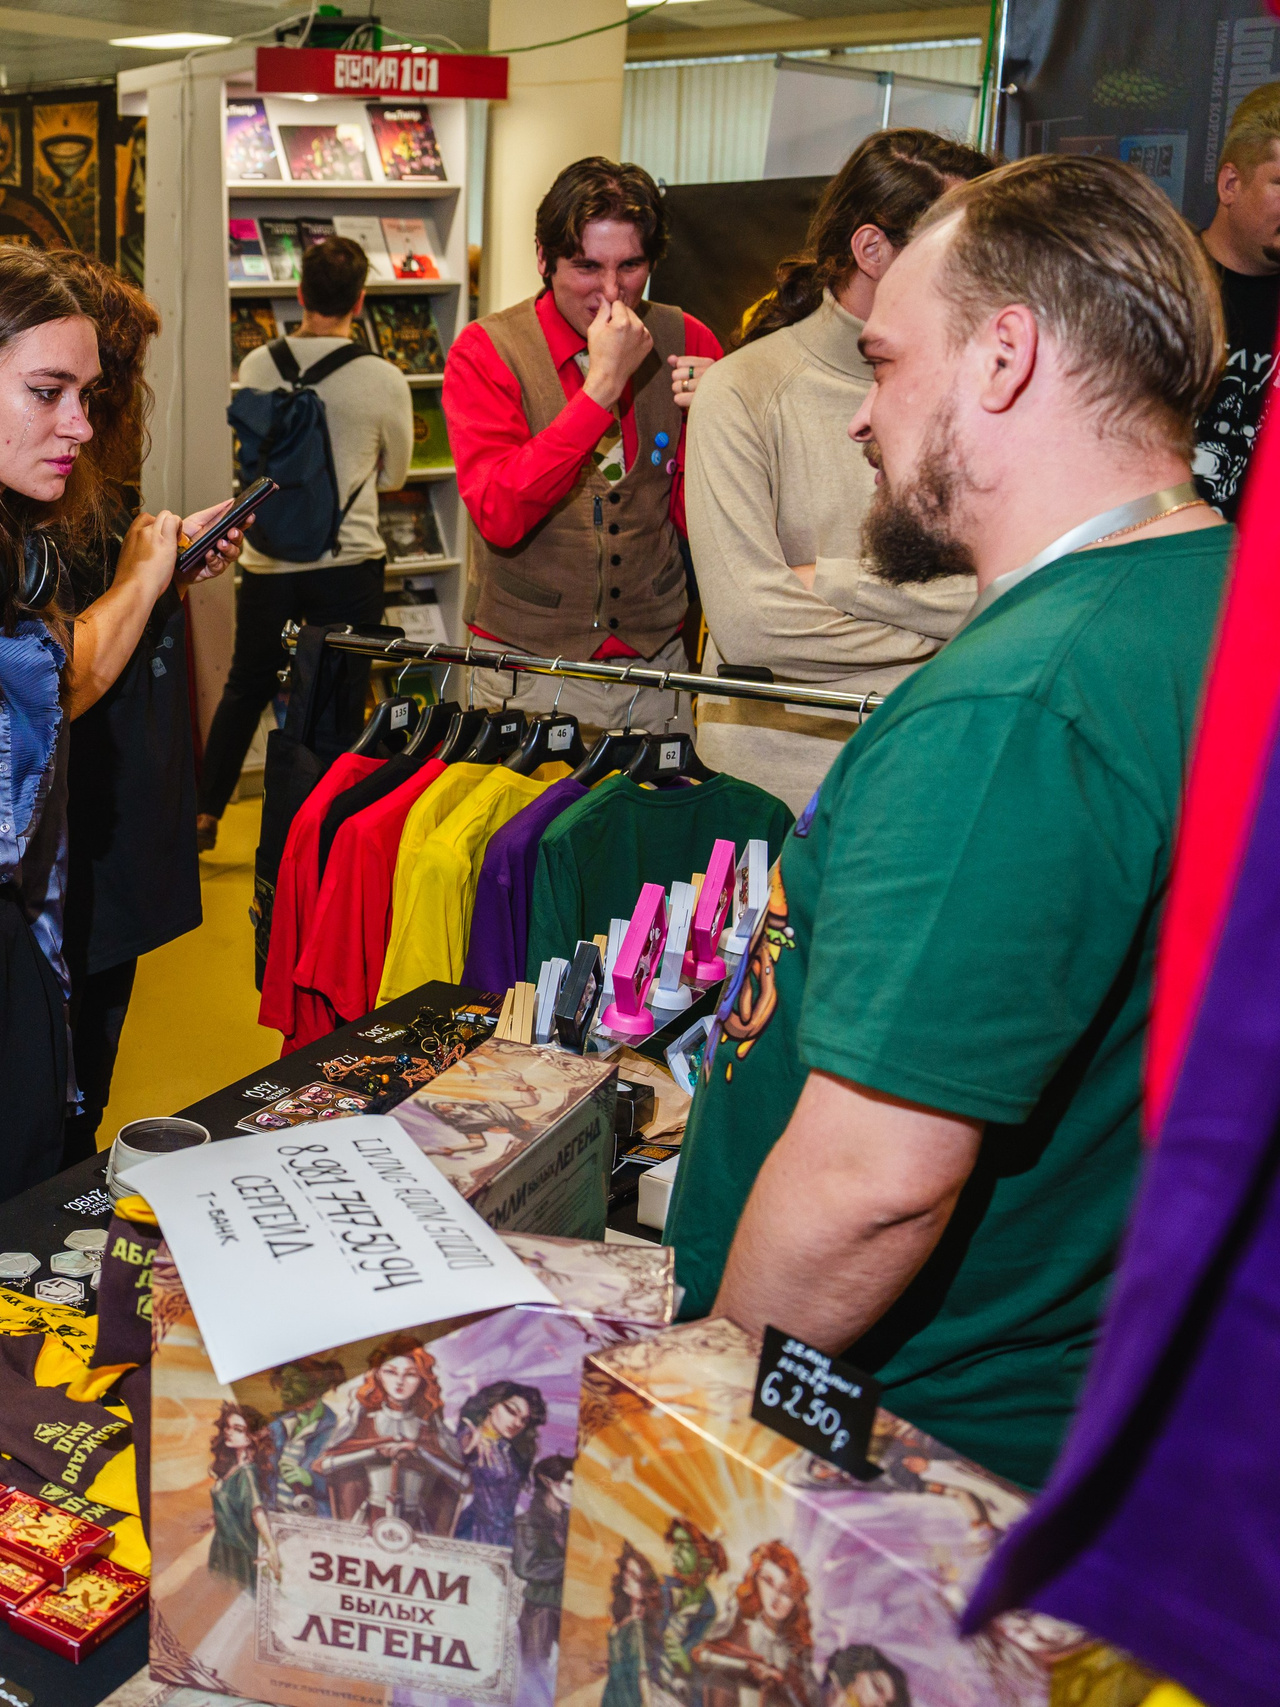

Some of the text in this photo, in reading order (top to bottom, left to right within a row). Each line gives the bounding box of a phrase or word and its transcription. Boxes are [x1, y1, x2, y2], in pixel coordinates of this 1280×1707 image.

[334, 53, 440, 92] СТУДИЯ 101
[393, 705, 409, 720] 135
[556, 727, 568, 739] 46
[665, 749, 677, 761] 62
[288, 1158, 356, 1187] 981
[352, 1138, 418, 1183] LIVING
[394, 1187, 458, 1222] ROOM
[196, 1191, 239, 1247] Т-БАНК
[231, 1174, 311, 1237] СЕРГЕЙ
[316, 1190, 383, 1228] 747
[342, 1230, 402, 1254] 50
[359, 1256, 424, 1292] 94
[51, 1420, 95, 1453] ДНД
[308, 1551, 471, 1605] ЗЕМЛИ
[339, 1594, 434, 1626] БЫЛЫХ
[292, 1615, 480, 1672] ЛЕГЕНД
